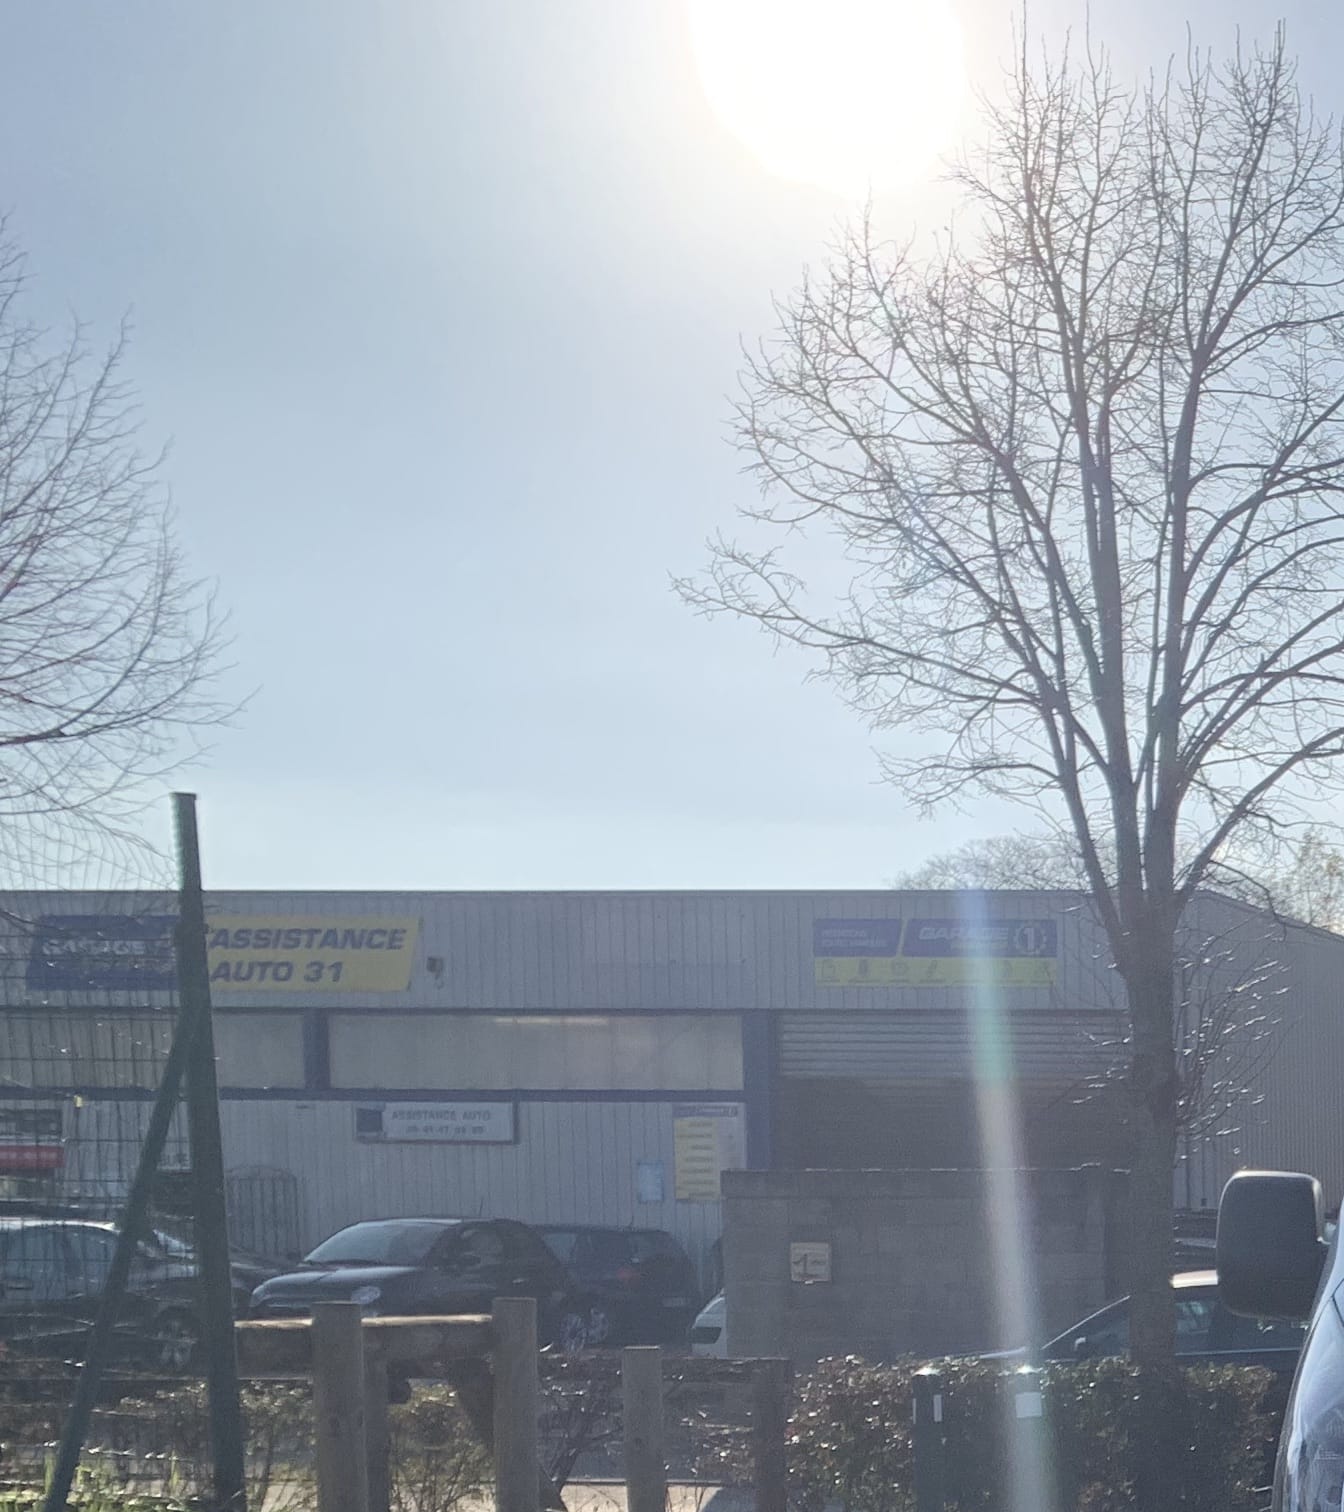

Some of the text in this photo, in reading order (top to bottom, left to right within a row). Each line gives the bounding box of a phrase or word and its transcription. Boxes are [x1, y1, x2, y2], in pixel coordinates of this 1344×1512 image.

[209, 928, 407, 949] ASSISTANCE
[209, 961, 344, 982] AUTO 31
[462, 1110, 491, 1122] AUTO
